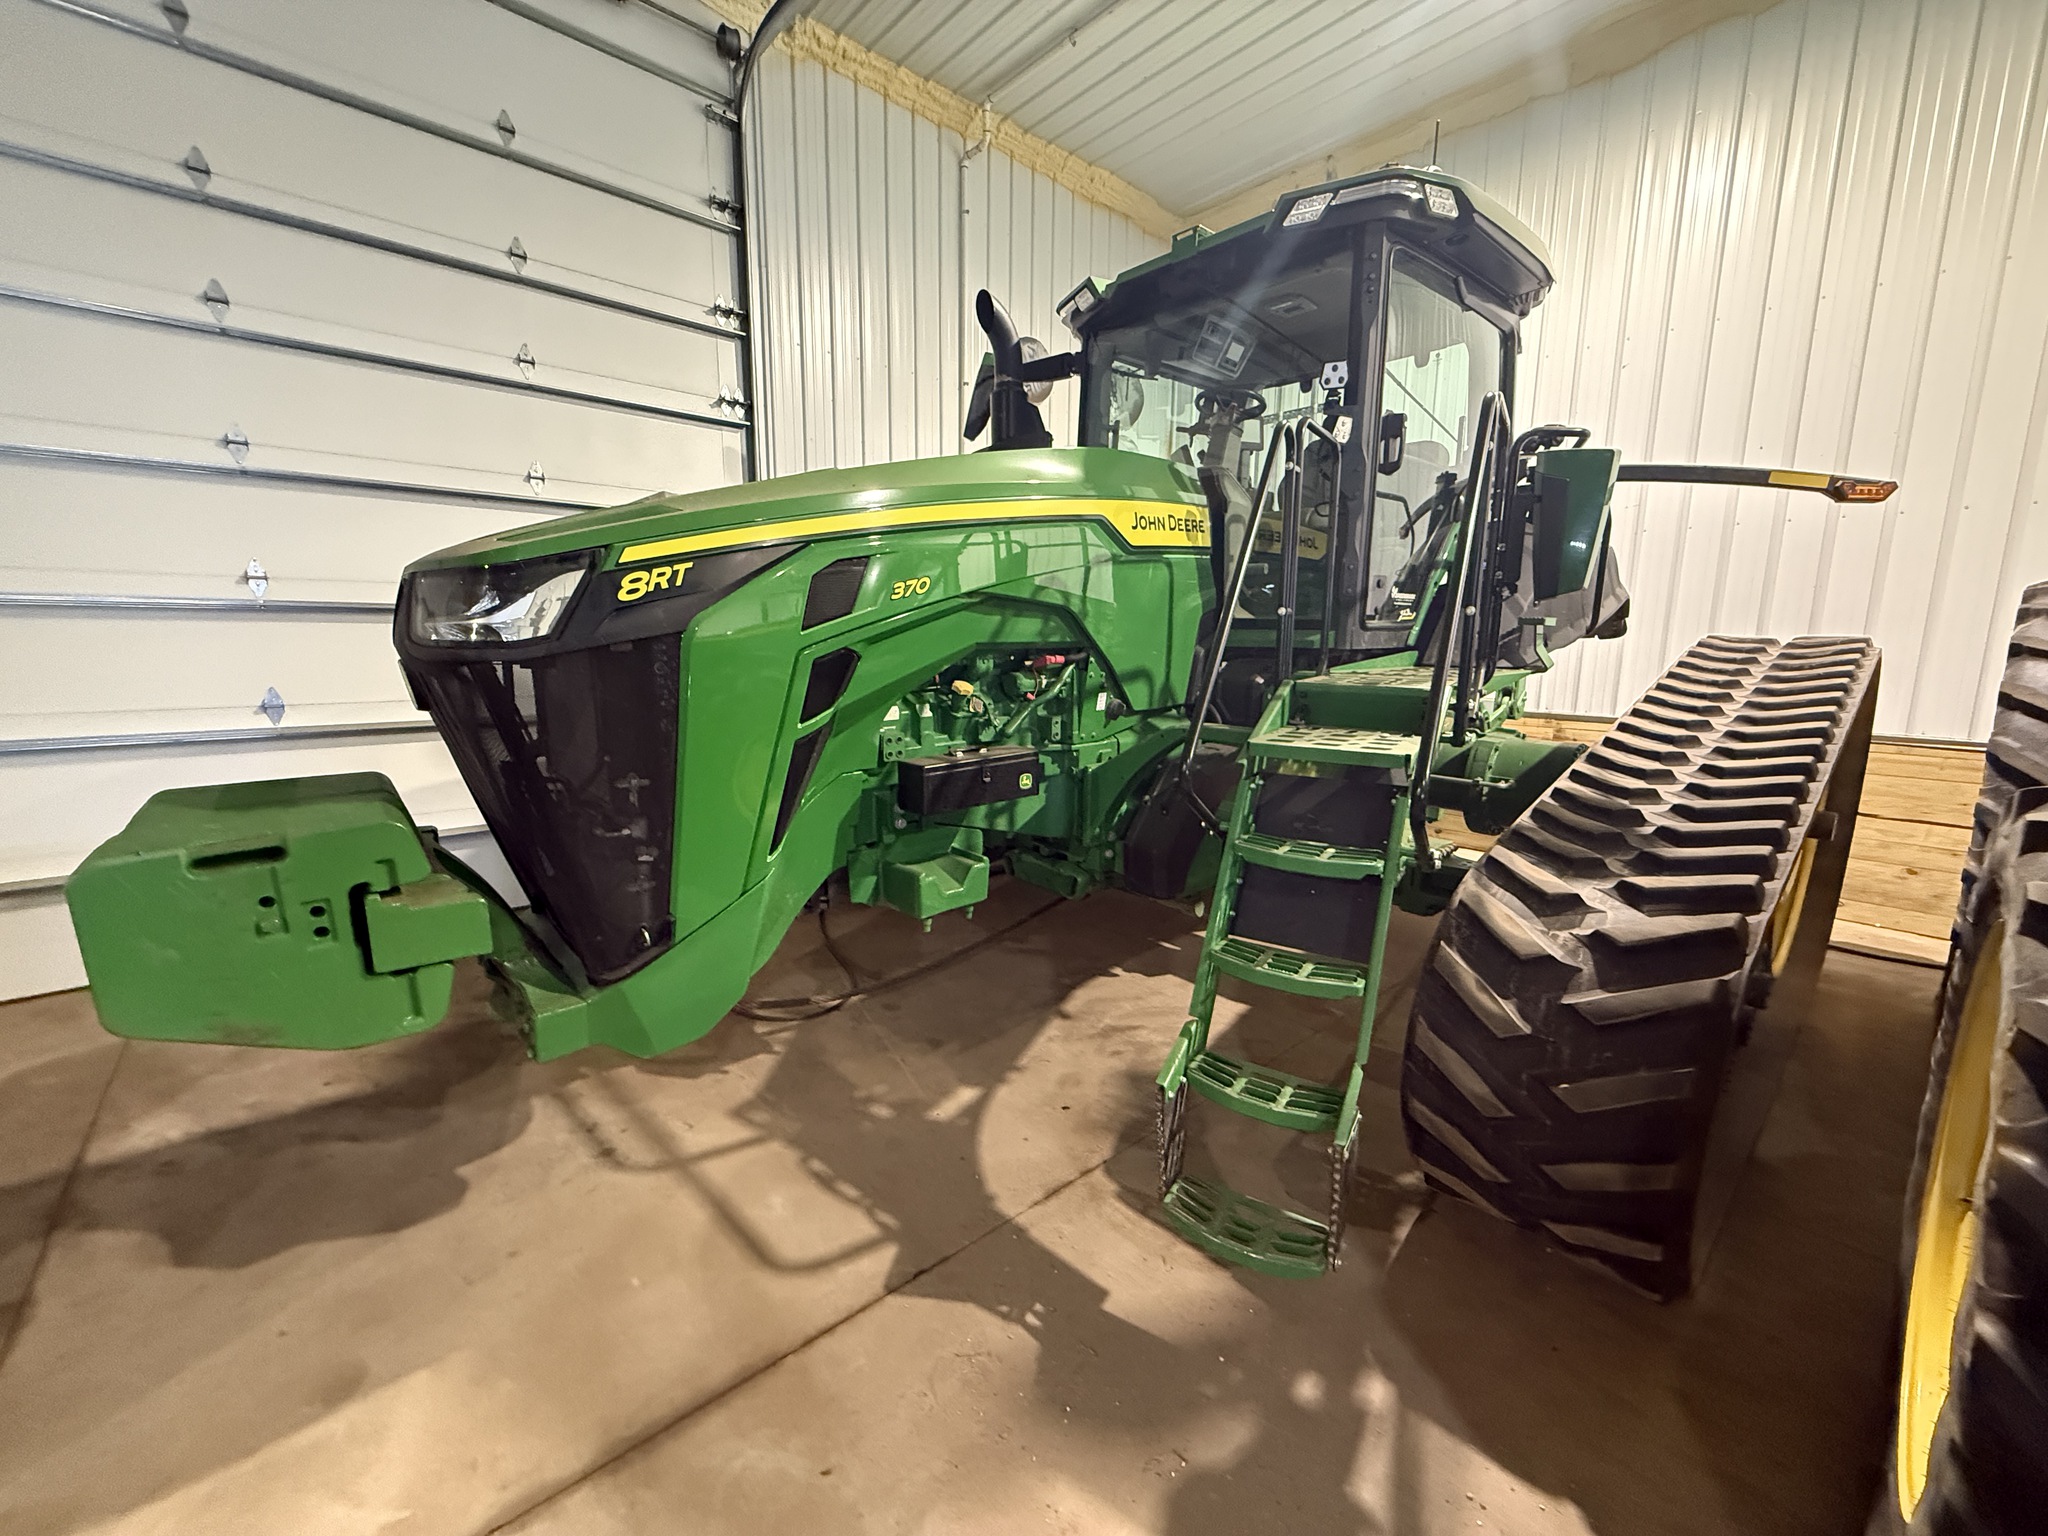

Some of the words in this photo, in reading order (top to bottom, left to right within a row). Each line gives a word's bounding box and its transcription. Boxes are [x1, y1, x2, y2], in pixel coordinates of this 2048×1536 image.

[1131, 511, 1166, 531] JOHN
[1167, 514, 1206, 533] DEERE
[617, 561, 694, 601] 8RT
[890, 576, 931, 600] 370
